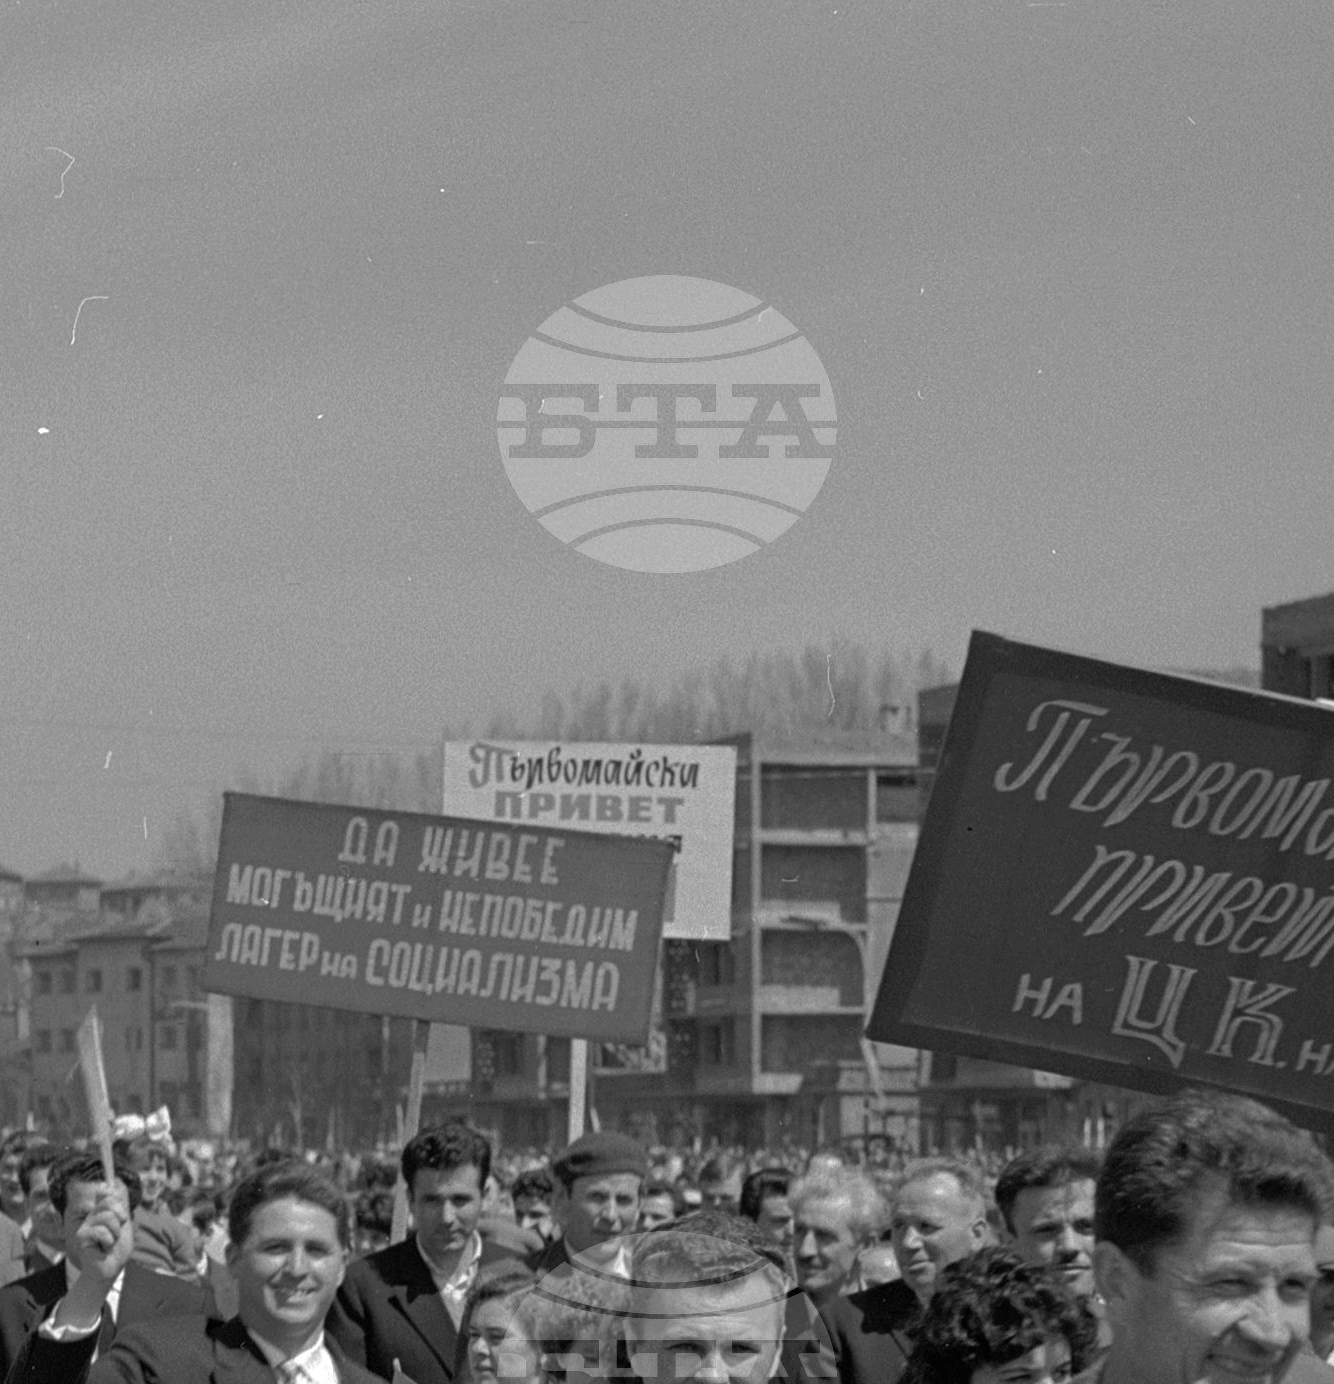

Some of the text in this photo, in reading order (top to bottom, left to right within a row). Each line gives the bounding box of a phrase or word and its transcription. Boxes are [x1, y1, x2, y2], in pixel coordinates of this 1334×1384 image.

[494, 790, 685, 823] ПРИВЕТ
[338, 816, 566, 885] ДА ЖИВЕЕ
[226, 863, 412, 927] МОГЪЩИЯТ
[438, 889, 639, 952] НЕПОБЕДИМ
[214, 922, 320, 972] ЛАГЕР
[366, 938, 619, 1012] СОЦИАЛИЗМА
